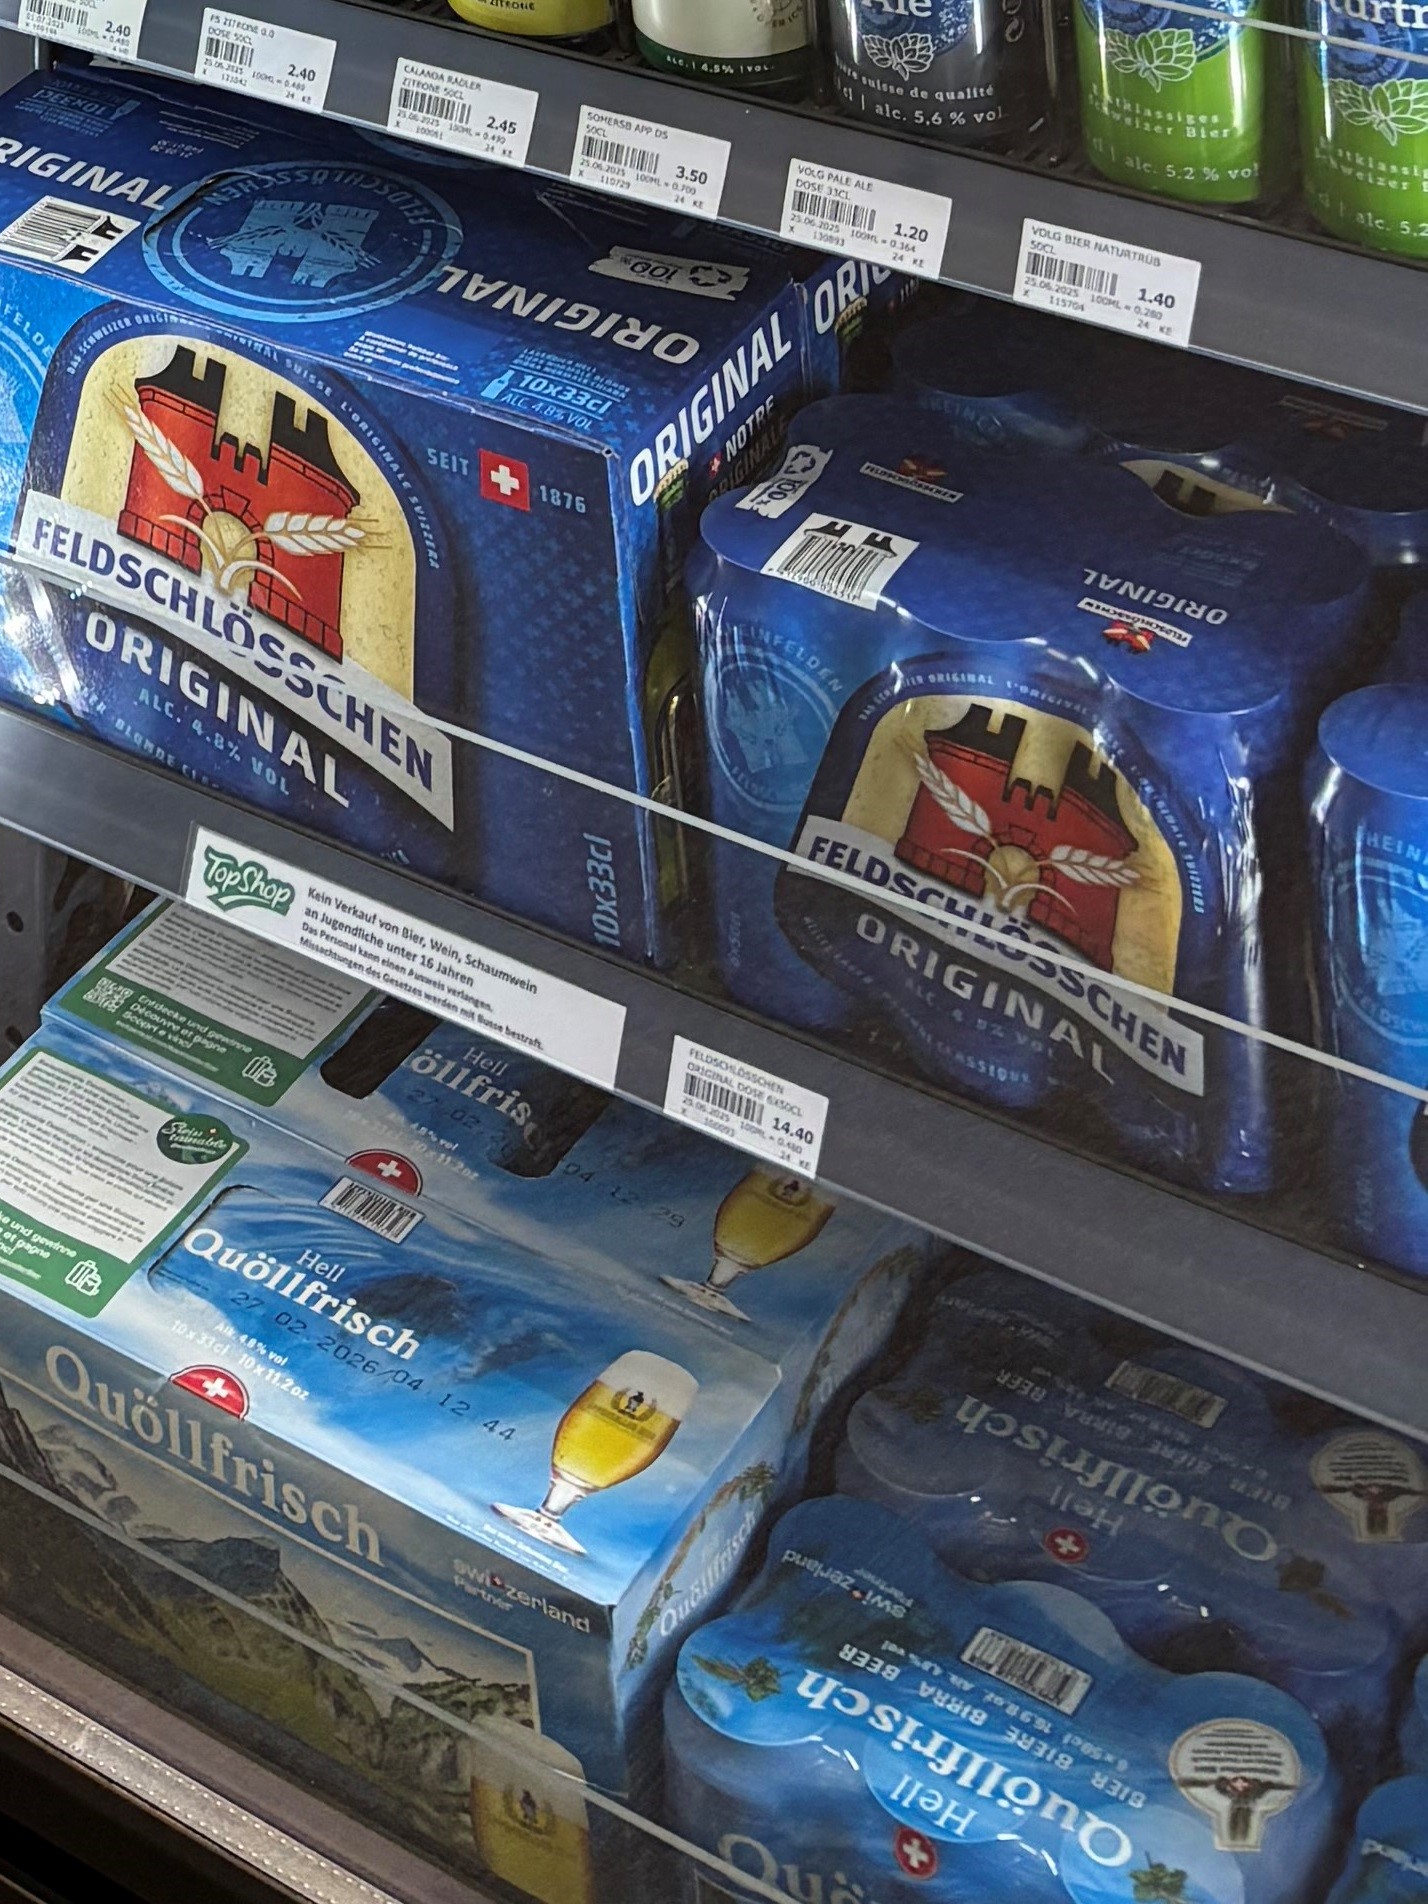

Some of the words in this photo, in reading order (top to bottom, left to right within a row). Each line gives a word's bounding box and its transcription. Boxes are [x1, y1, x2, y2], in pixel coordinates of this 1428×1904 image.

[105, 20, 131, 37] 2.40
[288, 64, 316, 82] 2.40
[908, 83, 930, 98] de
[934, 83, 995, 103] qualité
[487, 116, 517, 135] 2.45
[874, 104, 909, 124] alc.
[948, 109, 967, 127] %
[675, 166, 708, 185] 3.50
[796, 178, 825, 193] DOSE
[798, 165, 825, 182] VOLG
[827, 172, 852, 187] PALE
[854, 180, 874, 192] ALE
[1202, 165, 1221, 181] %
[894, 223, 929, 243] 1.20
[1030, 240, 1056, 255] 50CL
[1032, 226, 1061, 241] VOLG
[1065, 235, 1091, 249] BIER
[1094, 241, 1161, 267] NATURTRÜB
[1138, 288, 1175, 309] 1.40
[518, 371, 612, 416] 10x33cl
[628, 308, 793, 506] ORIGINAL
[426, 447, 470, 477] SEIT
[538, 484, 587, 515] 1876
[1083, 567, 1230, 626] ORIGINAL
[32, 516, 434, 794] FELDSCHLÖSSCHEN
[85, 608, 353, 810] ORIGINAL
[138, 686, 184, 722] ALC.
[191, 717, 245, 763] 4.8%
[250, 756, 292, 797] VOL
[583, 833, 621, 948] 10x33cl
[301, 922, 317, 937] Das
[319, 928, 357, 952] Personal
[305, 907, 318, 921] an
[320, 911, 384, 947] Jugendliche
[387, 935, 417, 961] unter
[420, 952, 434, 968] 16
[435, 959, 474, 988] Jahren
[308, 886, 332, 906] Kein
[334, 898, 377, 925] Verkauf
[379, 917, 399, 935] von
[402, 925, 427, 949] Bier,
[430, 936, 462, 963] Wein,
[465, 953, 538, 995] Schaumwein
[808, 834, 1188, 1076] FELDSCHLÖSSCHEN
[857, 911, 1117, 1084] ORIGINAL
[773, 1117, 814, 1144] 14.40
[297, 1249, 346, 1283] Hell
[183, 1227, 421, 1361] Quöllfrisch
[44, 1344, 385, 1569] Quöllfrisch
[837, 1640, 901, 1682] BEER
[794, 1667, 1136, 1870] Quöllfrisch
[888, 1772, 978, 1839] Hell
